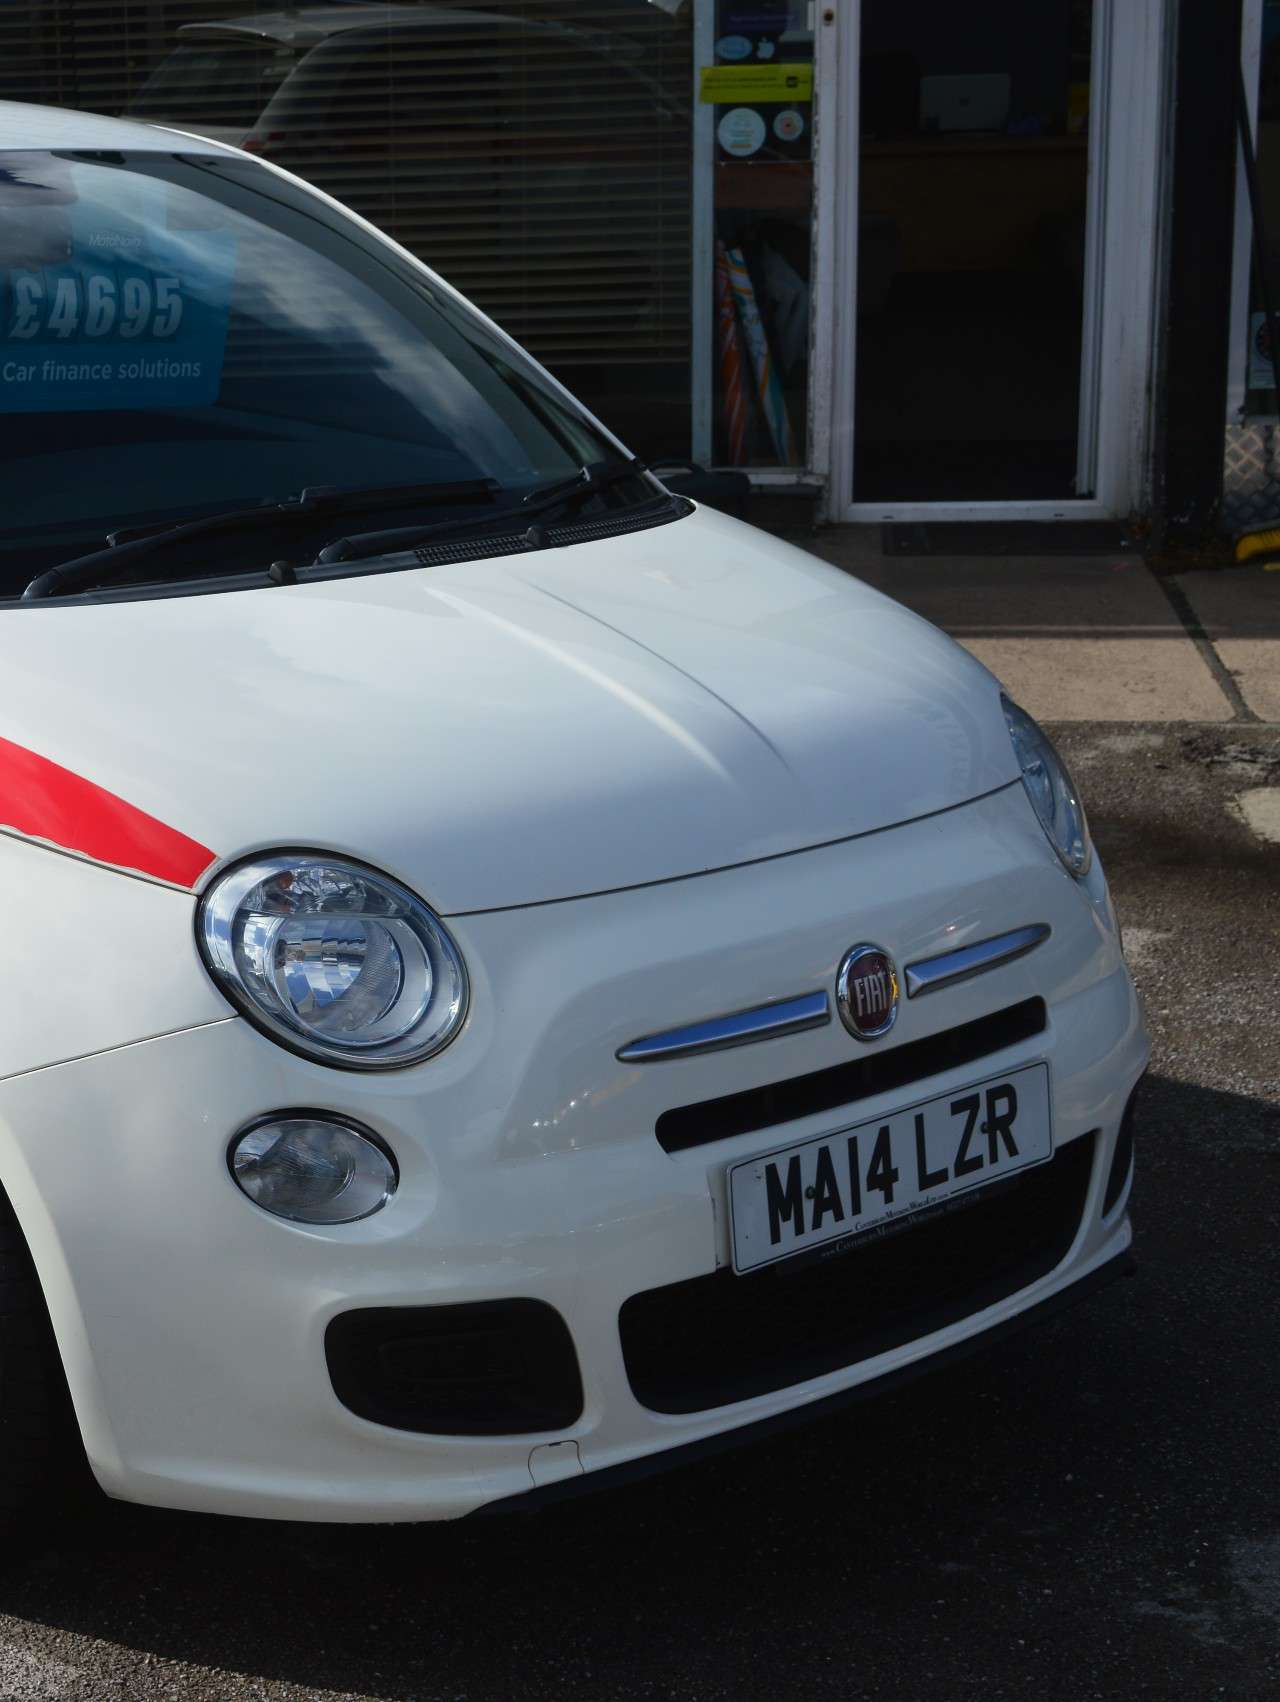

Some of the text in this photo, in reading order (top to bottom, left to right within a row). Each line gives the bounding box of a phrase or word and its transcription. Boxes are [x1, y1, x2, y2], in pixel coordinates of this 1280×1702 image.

[8, 275, 183, 339] £4695
[2, 357, 201, 382] Car finance solutions
[855, 971, 888, 1017] FIAT
[764, 1124, 899, 1245] MA14
[914, 1083, 1020, 1192] LZR
